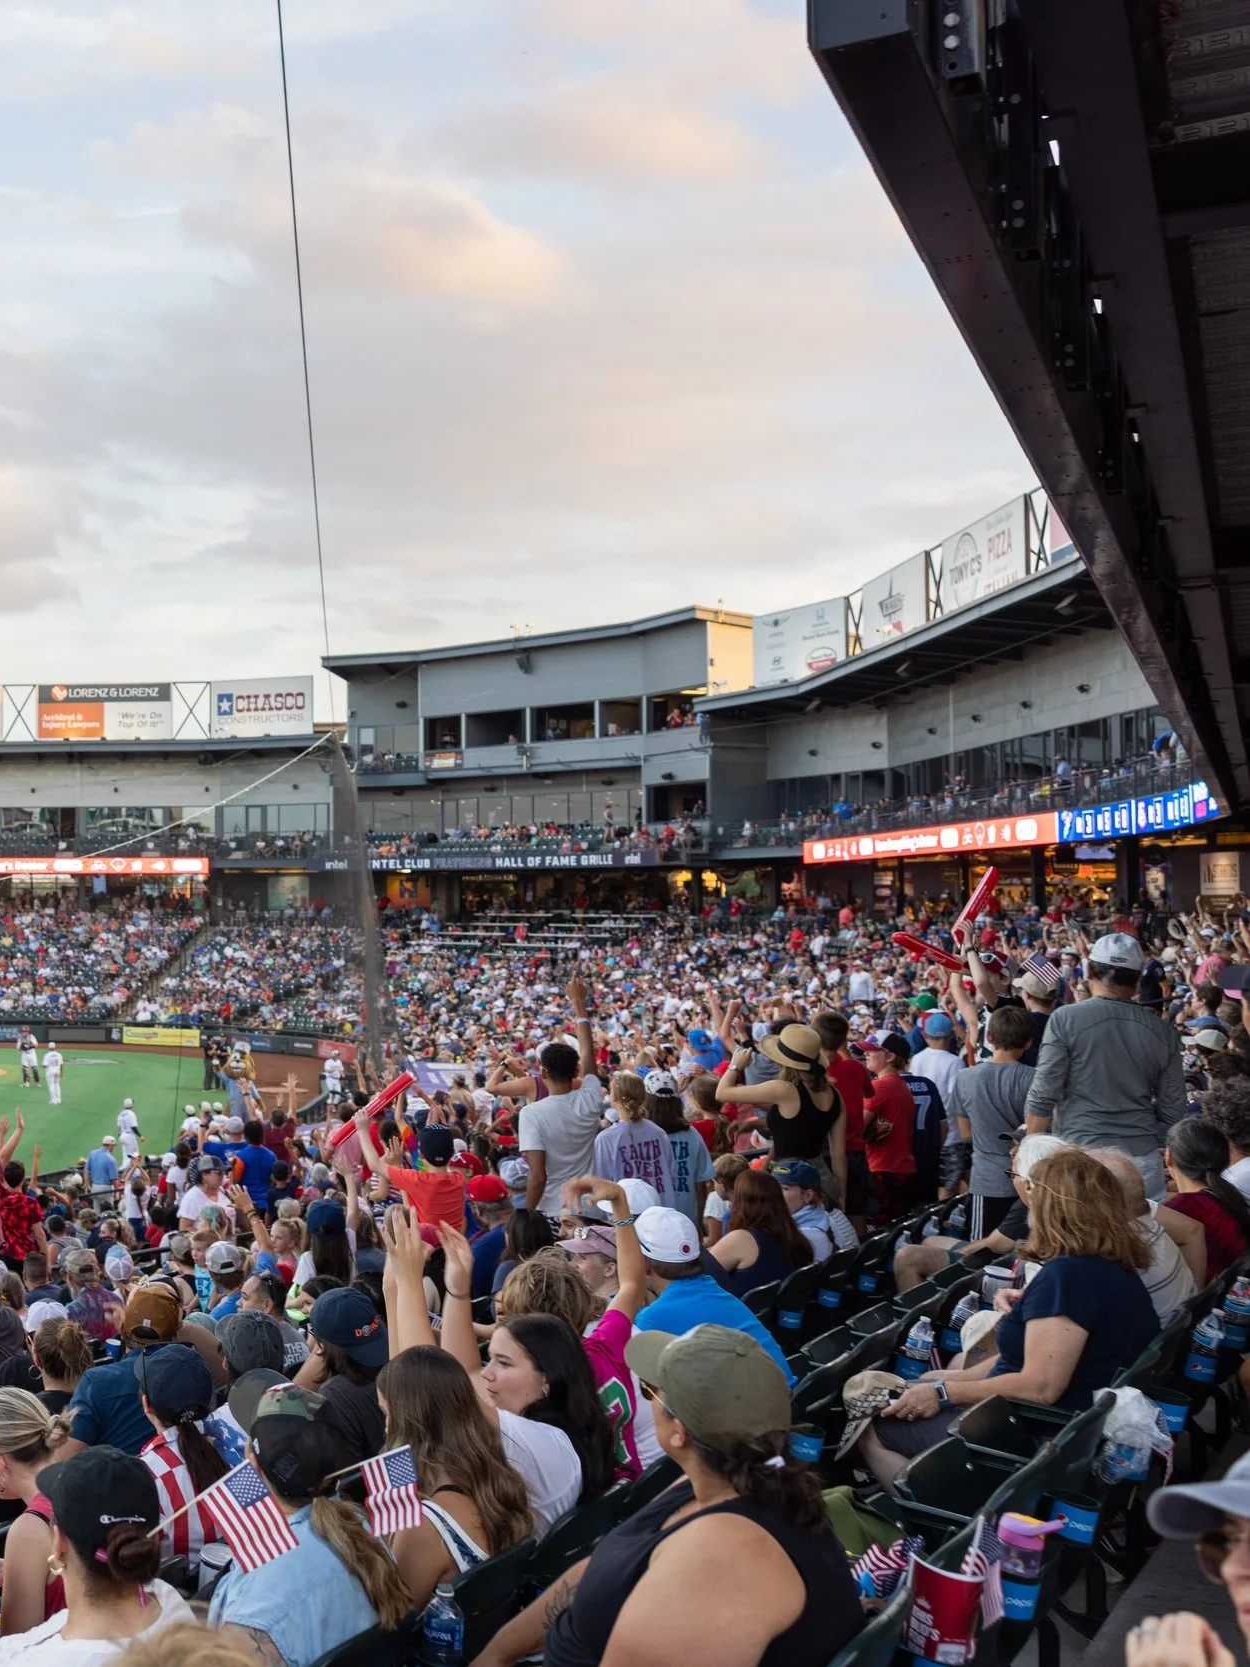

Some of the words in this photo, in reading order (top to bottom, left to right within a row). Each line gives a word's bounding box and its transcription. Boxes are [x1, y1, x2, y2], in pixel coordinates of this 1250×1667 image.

[987, 528, 1013, 564] PIZZA
[950, 563, 970, 587] TONY
[68, 688, 109, 698] LORENZ
[110, 688, 118, 697] &
[119, 687, 159, 697] LORENZ
[235, 692, 305, 713] CHASCO
[42, 713, 76, 721] Accident
[76, 713, 83, 721] &
[149, 711, 163, 720] On
[218, 712, 305, 725] CONSTRUCTORS
[42, 720, 66, 729] Injury
[67, 720, 101, 729] Lawyers
[118, 720, 135, 729] Top
[324, 861, 348, 870] intel
[404, 858, 431, 869] CLUB
[495, 857, 524, 867] HALL
[526, 856, 541, 867] OF
[545, 855, 577, 866] FAME
[580, 853, 613, 865] GRILLE
[618, 1139, 661, 1163] FAITH
[624, 1160, 663, 1178] OVER
[99, 1514, 147, 1525] Champion
